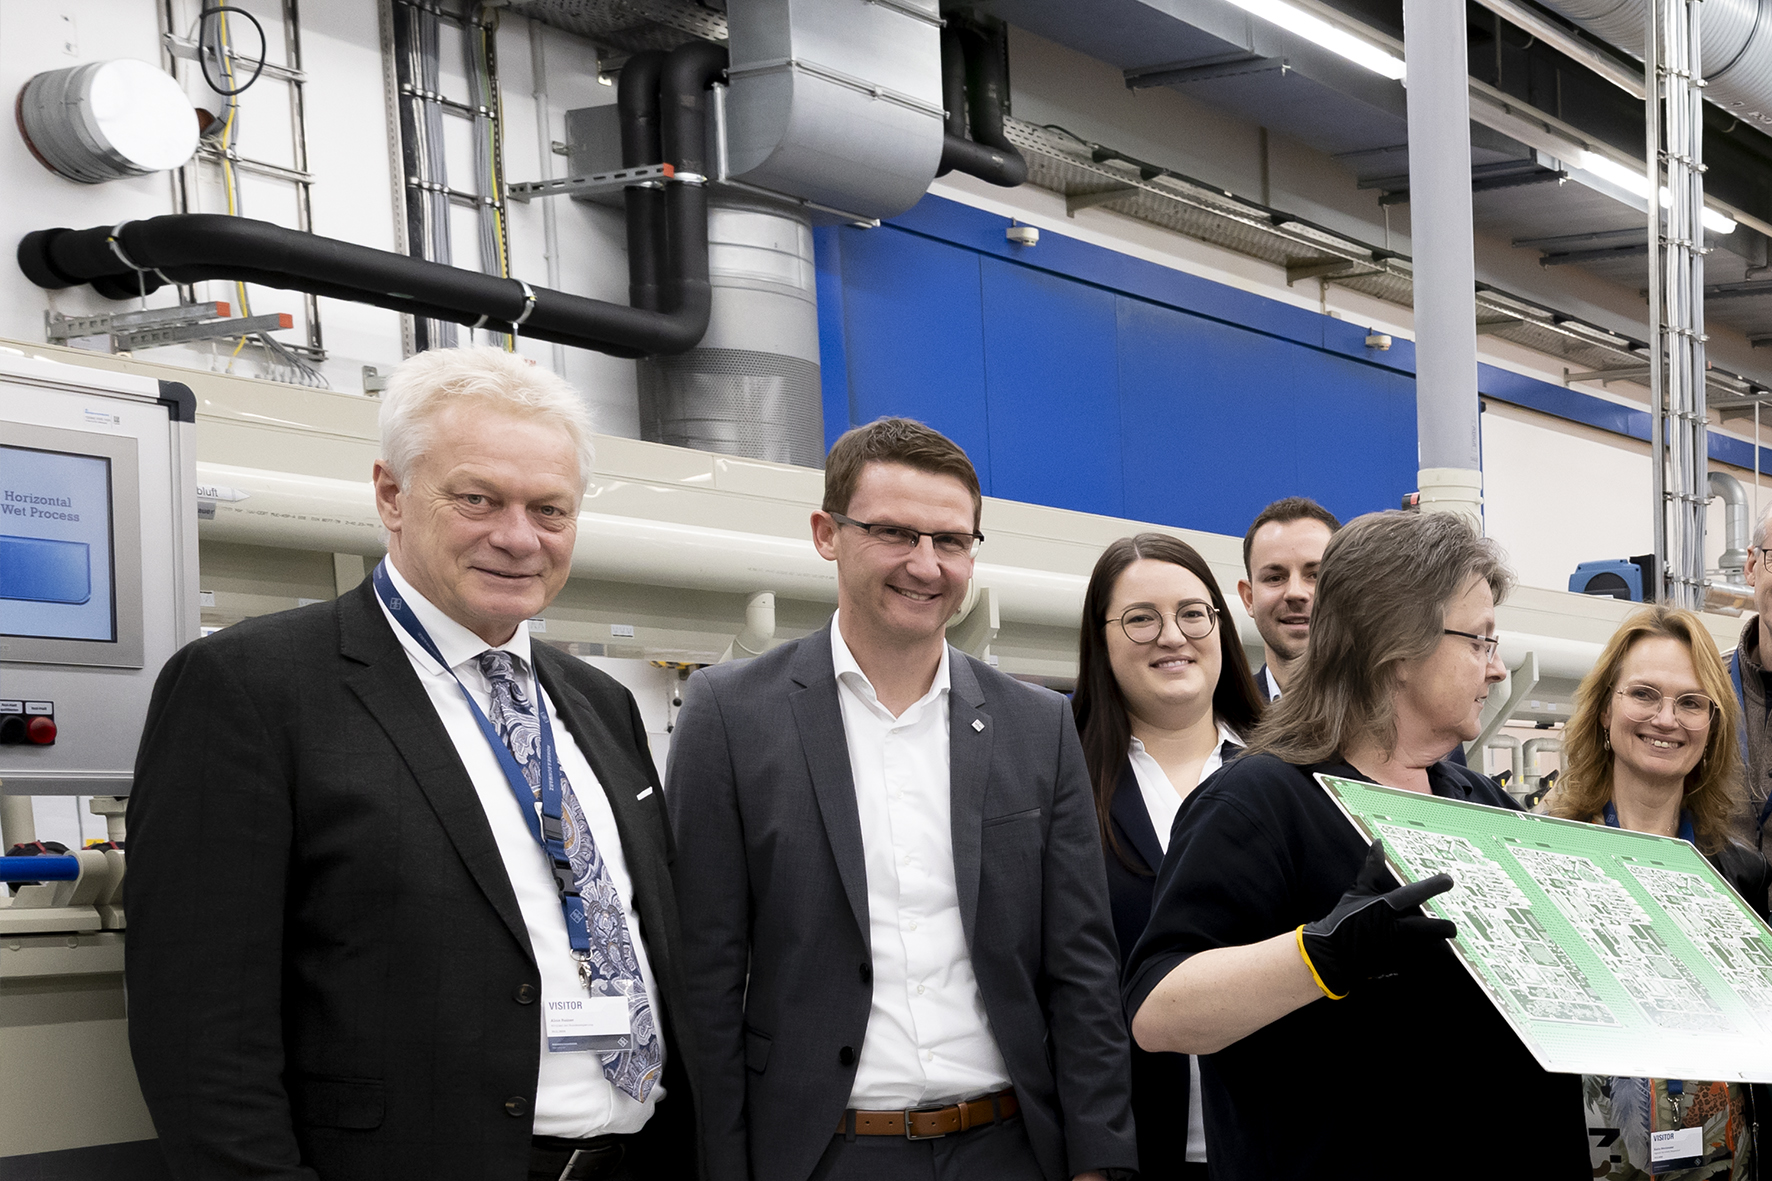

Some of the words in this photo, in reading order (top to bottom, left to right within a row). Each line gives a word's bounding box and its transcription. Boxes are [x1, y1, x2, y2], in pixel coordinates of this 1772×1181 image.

[197, 486, 218, 498] bluft
[4, 490, 73, 508] Horizontal
[1, 502, 27, 517] Wet
[30, 504, 80, 523] Process
[548, 1001, 583, 1010] VISITOR
[1653, 1132, 1675, 1142] VISITOR
